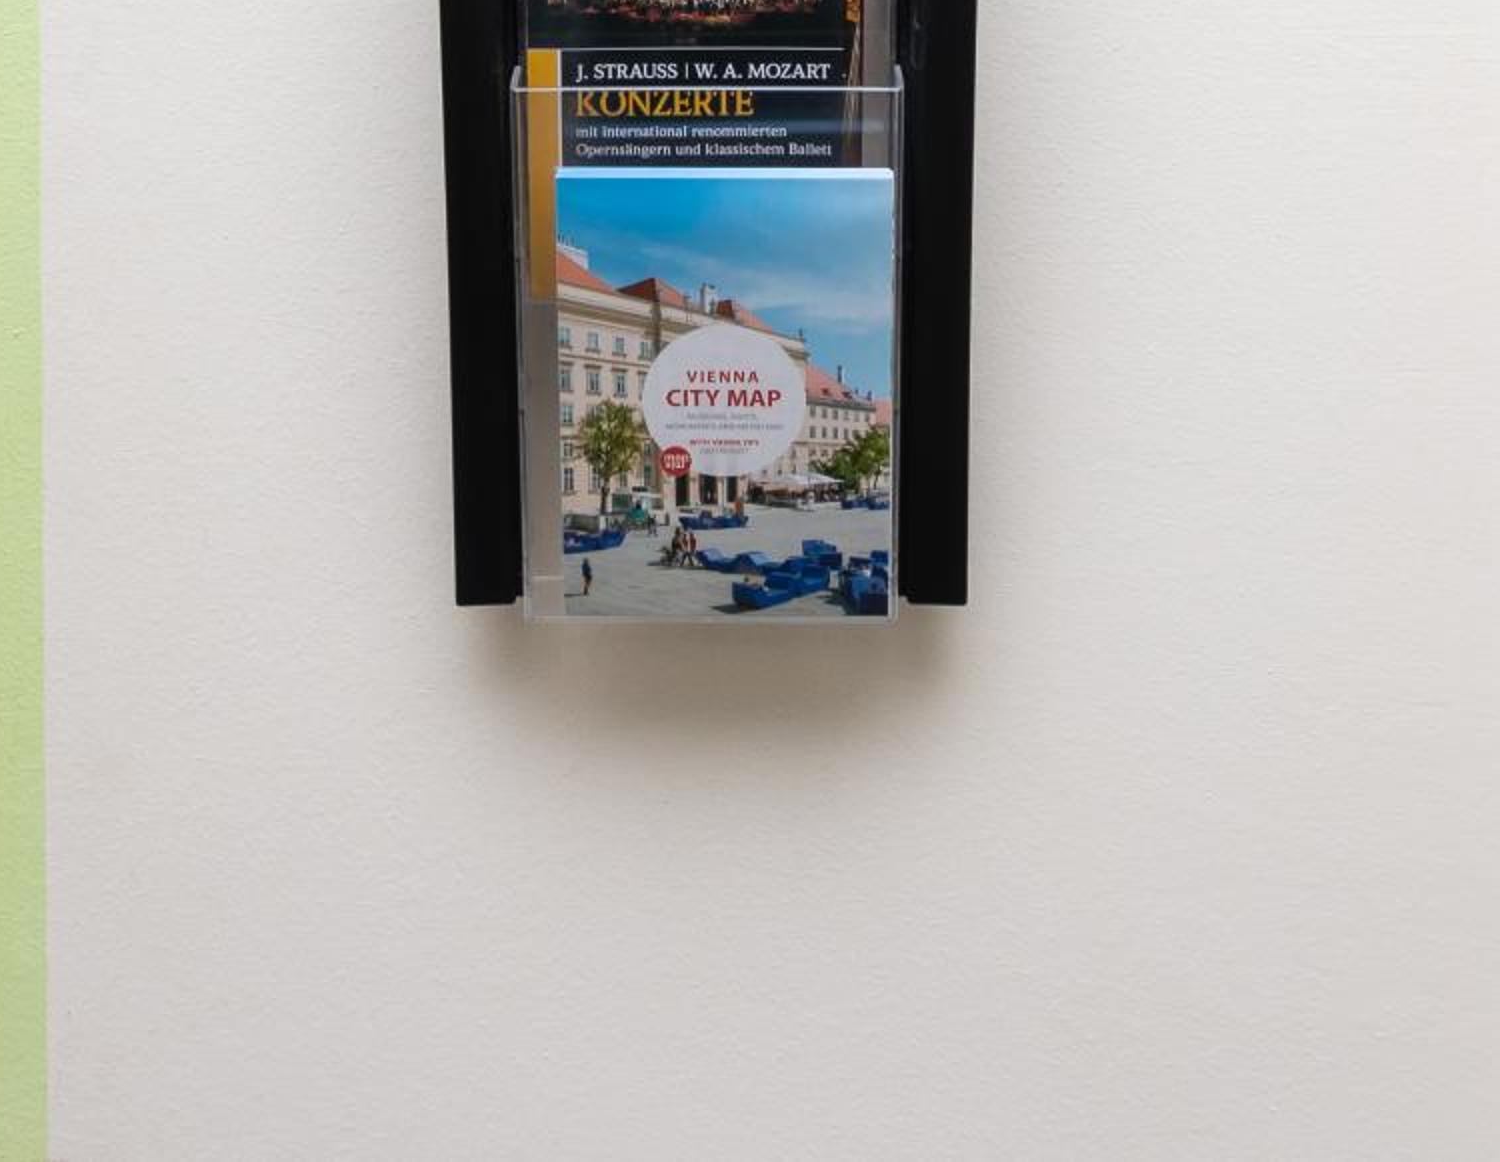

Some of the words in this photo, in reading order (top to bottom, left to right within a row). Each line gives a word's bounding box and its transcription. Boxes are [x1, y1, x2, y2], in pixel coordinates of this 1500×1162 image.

[575, 63, 589, 83] J.
[593, 62, 679, 80] STRAUSS
[694, 63, 718, 80] W.
[723, 63, 743, 79] A.
[747, 63, 832, 79] MOZART
[575, 89, 755, 118] KONZERTE
[575, 125, 598, 138] mit
[602, 124, 688, 138] international
[691, 125, 788, 138] renommierten
[576, 142, 672, 159] Opernsängern
[675, 142, 700, 156] und
[704, 142, 786, 156] klassischem
[788, 142, 832, 157] Ballett
[686, 370, 760, 384] VIENNA
[665, 389, 720, 407] CITY
[727, 389, 782, 407] MAP
